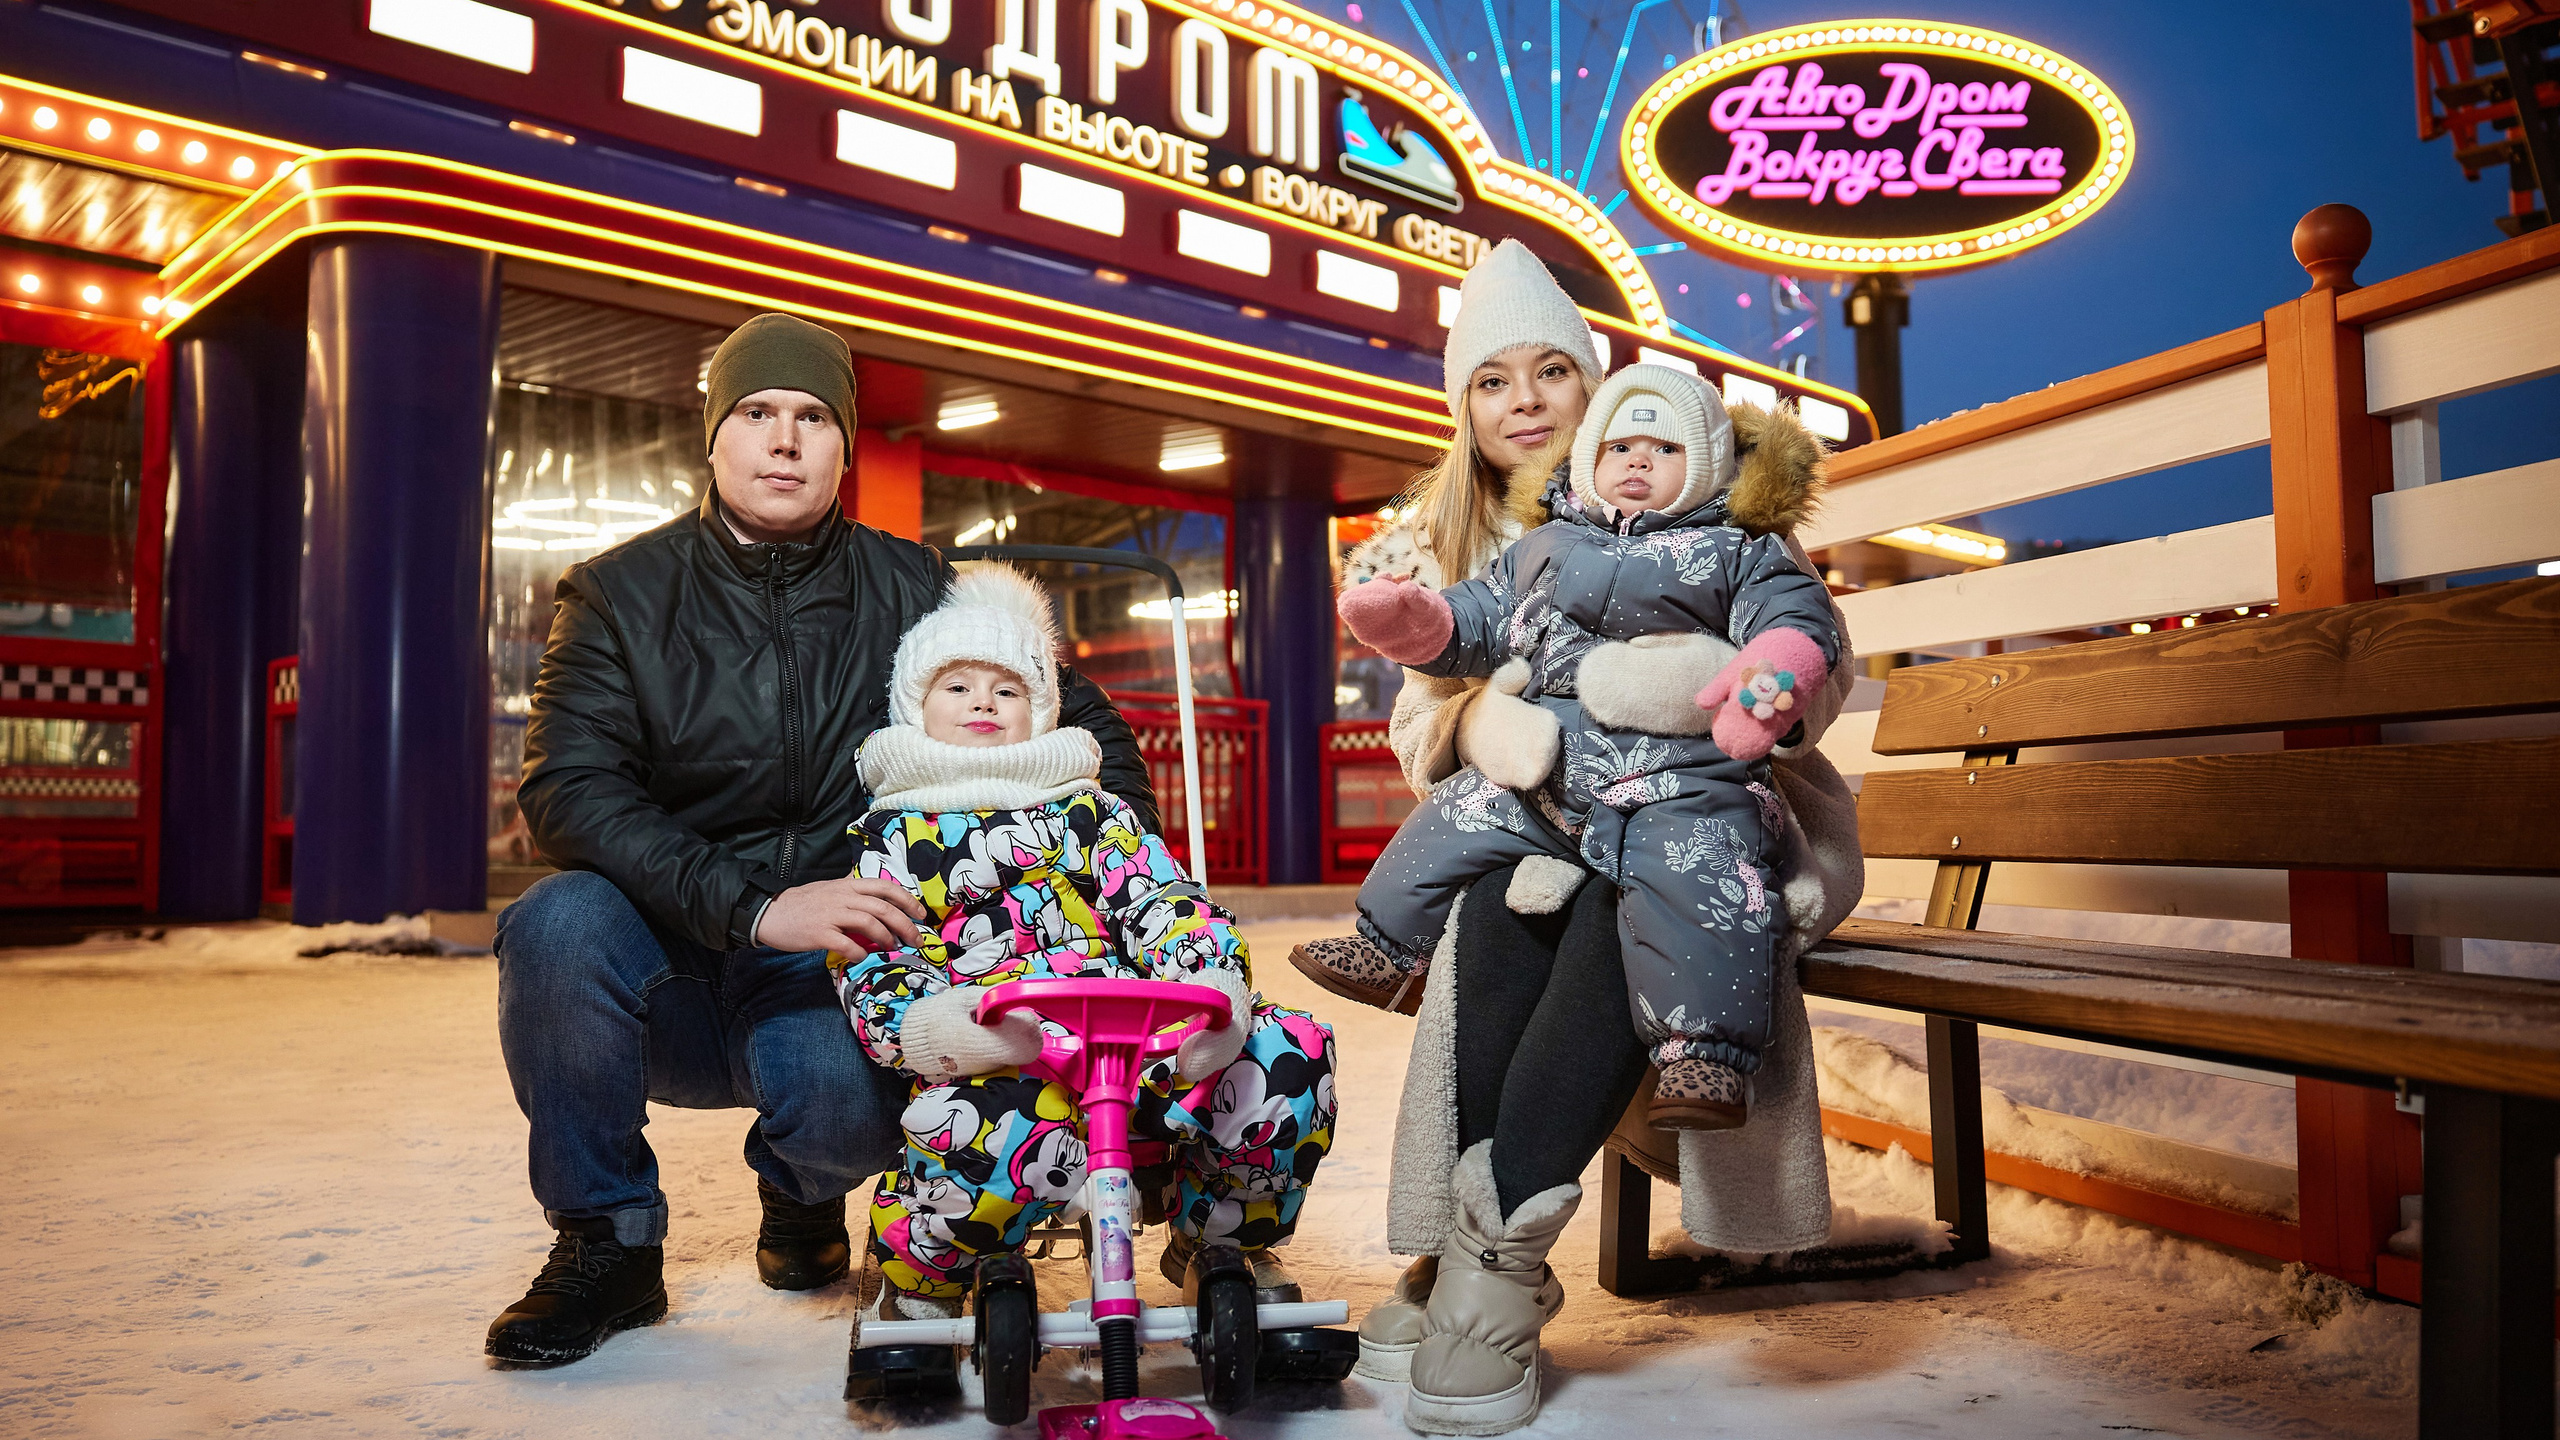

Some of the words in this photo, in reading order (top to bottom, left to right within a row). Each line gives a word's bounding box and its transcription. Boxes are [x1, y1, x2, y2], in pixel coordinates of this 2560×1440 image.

[706, 0, 937, 101] ЭМОЦИИ
[951, 67, 1022, 129] НА
[1035, 94, 1210, 188] ВЫСОТЕ
[1252, 165, 1389, 239] ВОКРУГ
[1709, 61, 1866, 133] Авто
[1852, 61, 2033, 139] Дром
[1695, 128, 1906, 206] Вокруг
[1909, 125, 2066, 190] Света
